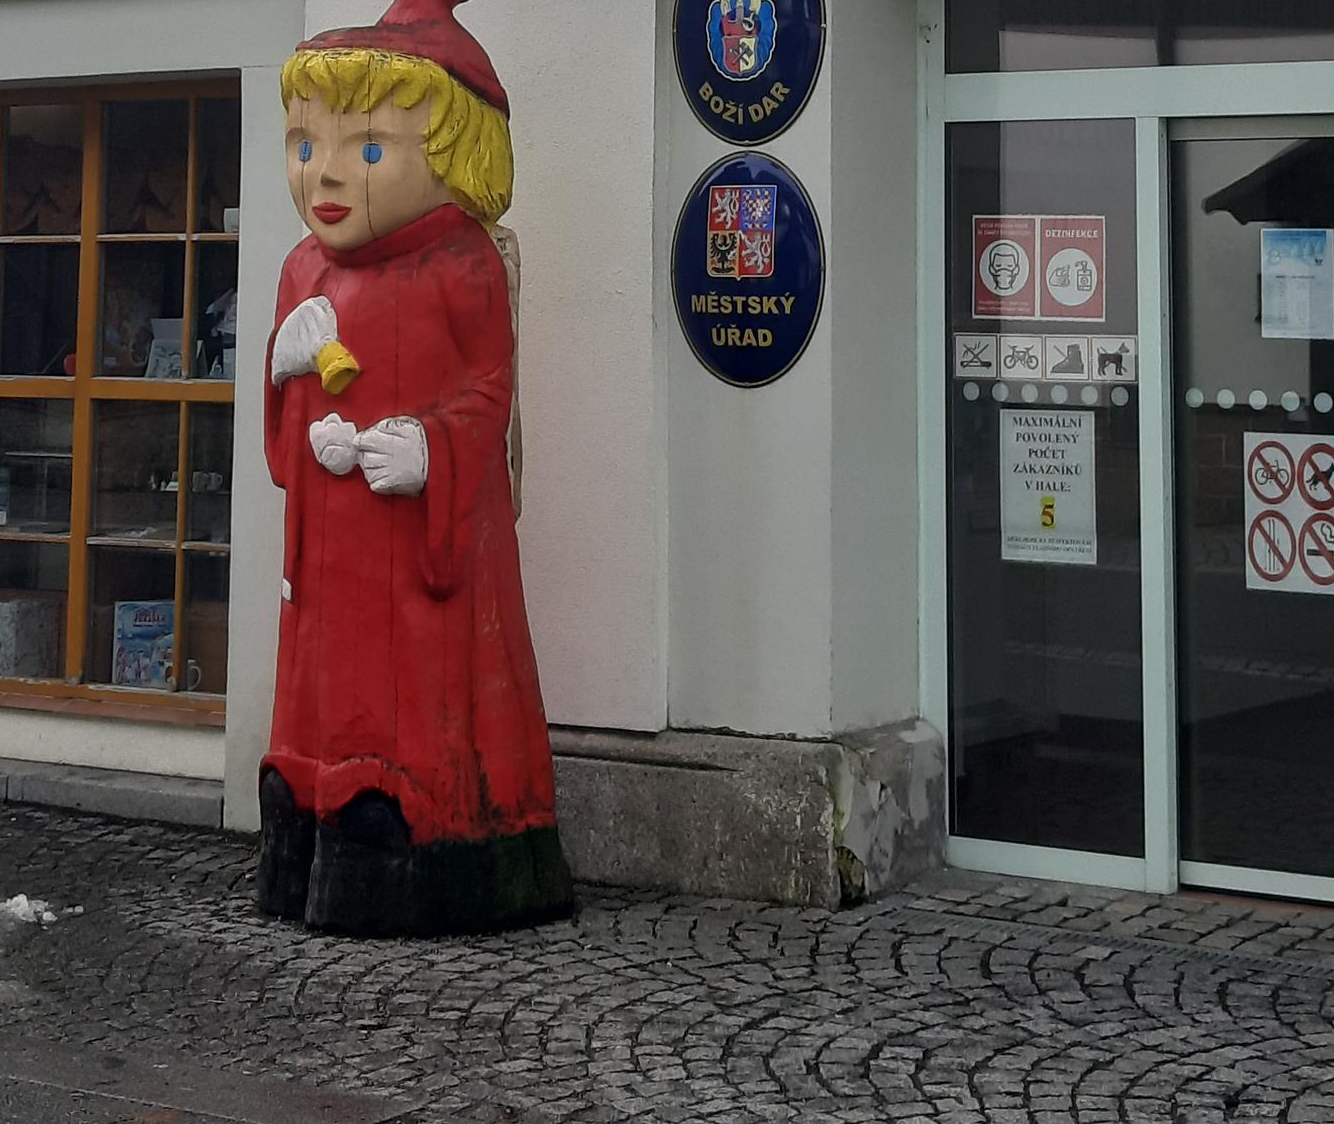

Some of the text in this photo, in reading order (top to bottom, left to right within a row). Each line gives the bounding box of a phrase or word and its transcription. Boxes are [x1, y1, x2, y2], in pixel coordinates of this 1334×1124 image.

[698, 81, 791, 125] BOŽÍ DAR
[1045, 229, 1099, 238] DEZINFEKCE
[690, 291, 796, 315] MĚSTSKÝ
[711, 323, 773, 347] ÚŘAD
[1012, 414, 1082, 429] MAXIMÁLNÍ
[1015, 431, 1080, 444] POVOLENÝ
[1028, 446, 1066, 460] POČET
[1012, 462, 1082, 476] ZÁKAZNÍKŮ
[1024, 480, 1071, 492] V HALE:
[1041, 503, 1055, 527] 5
